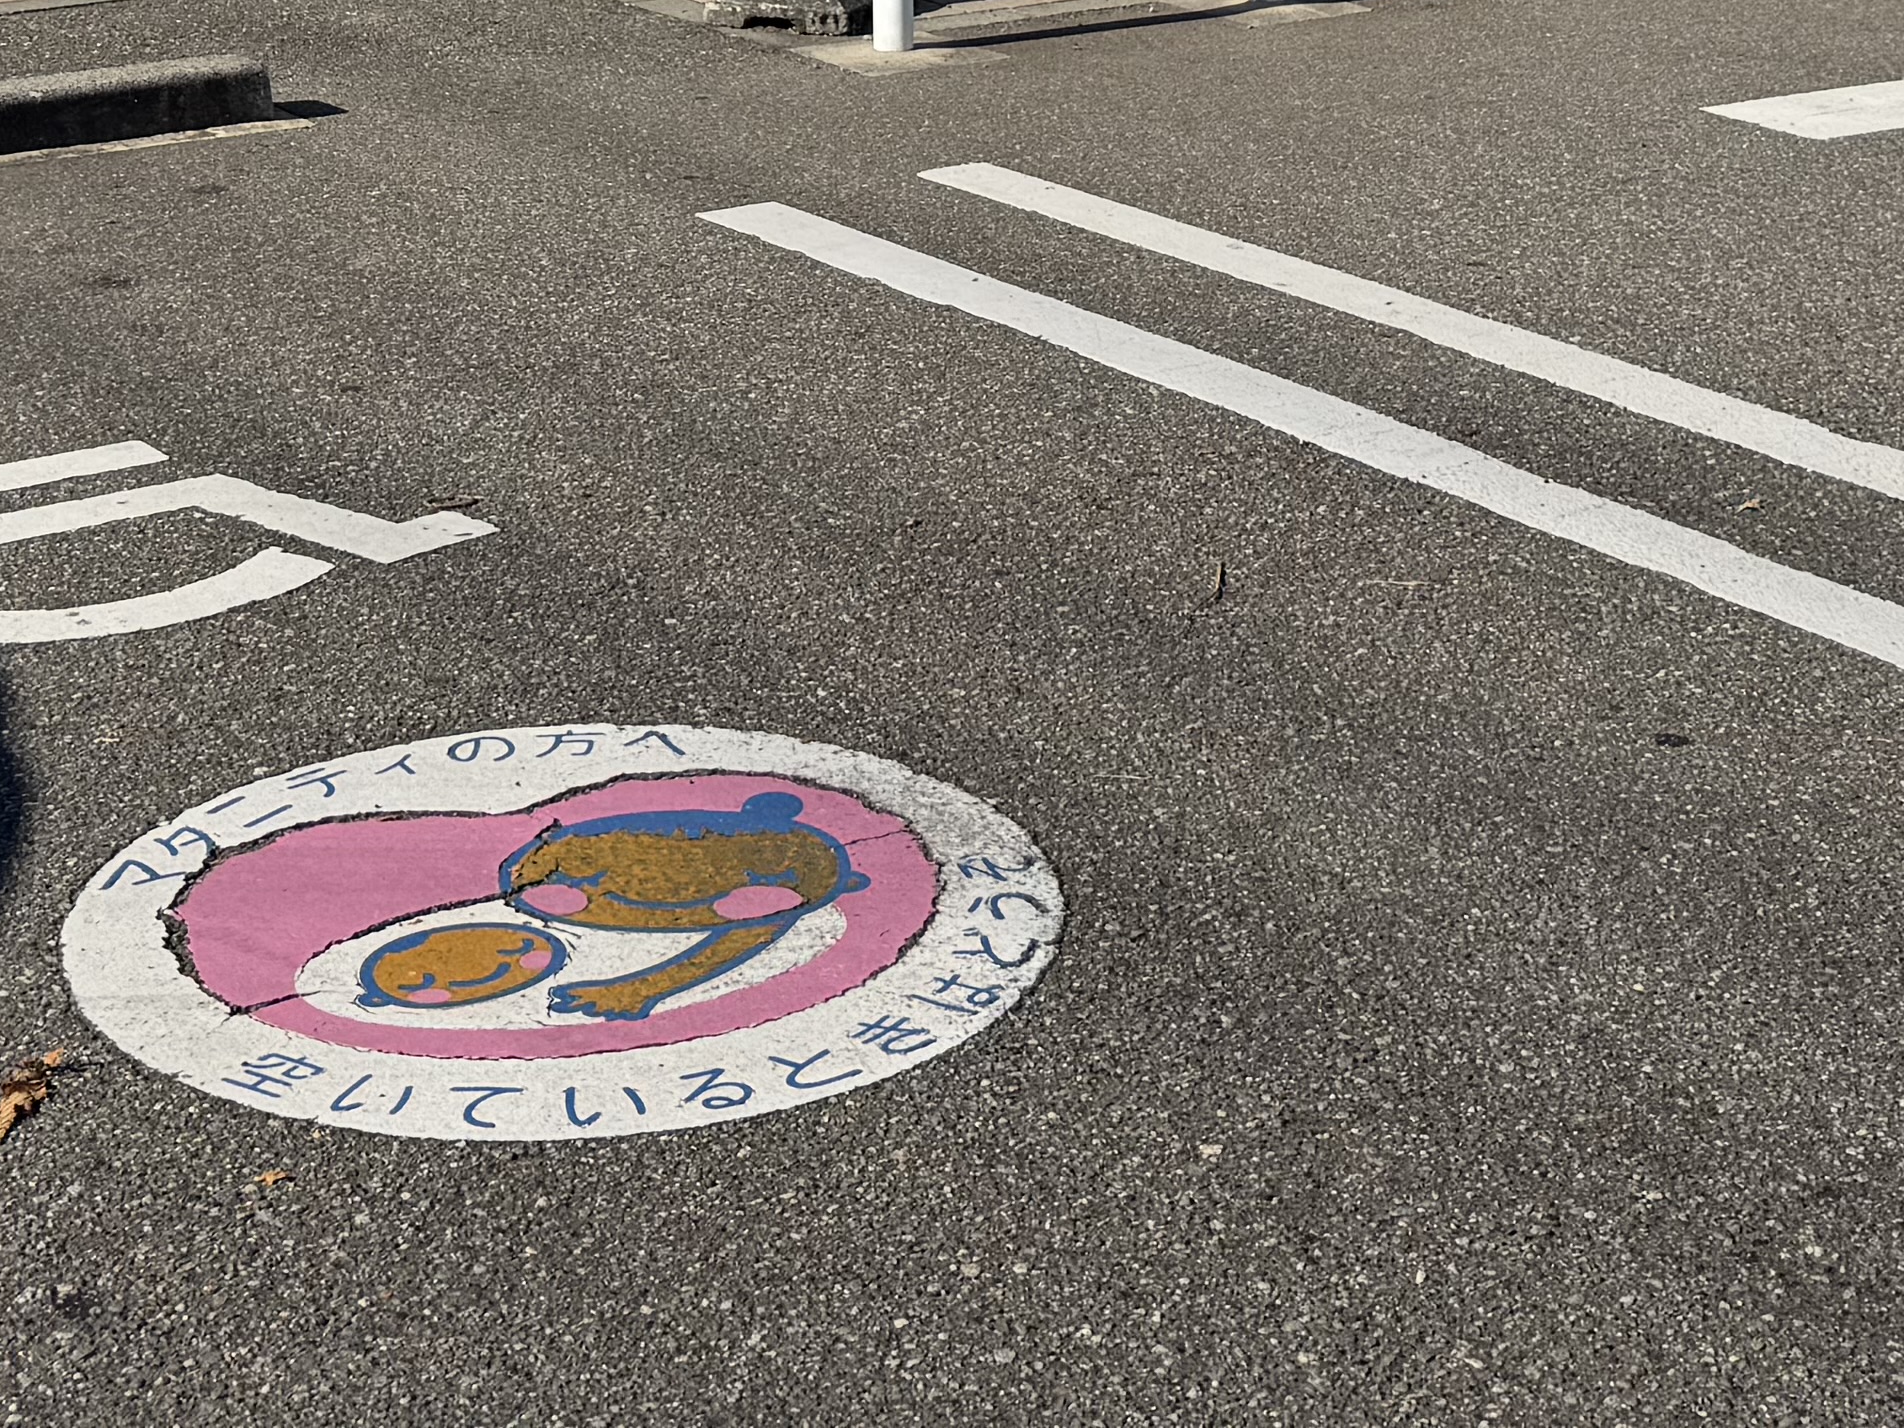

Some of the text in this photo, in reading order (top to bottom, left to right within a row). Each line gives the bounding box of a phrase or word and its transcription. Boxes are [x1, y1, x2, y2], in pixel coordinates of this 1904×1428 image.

[102, 729, 688, 891] マタニティの方へ
